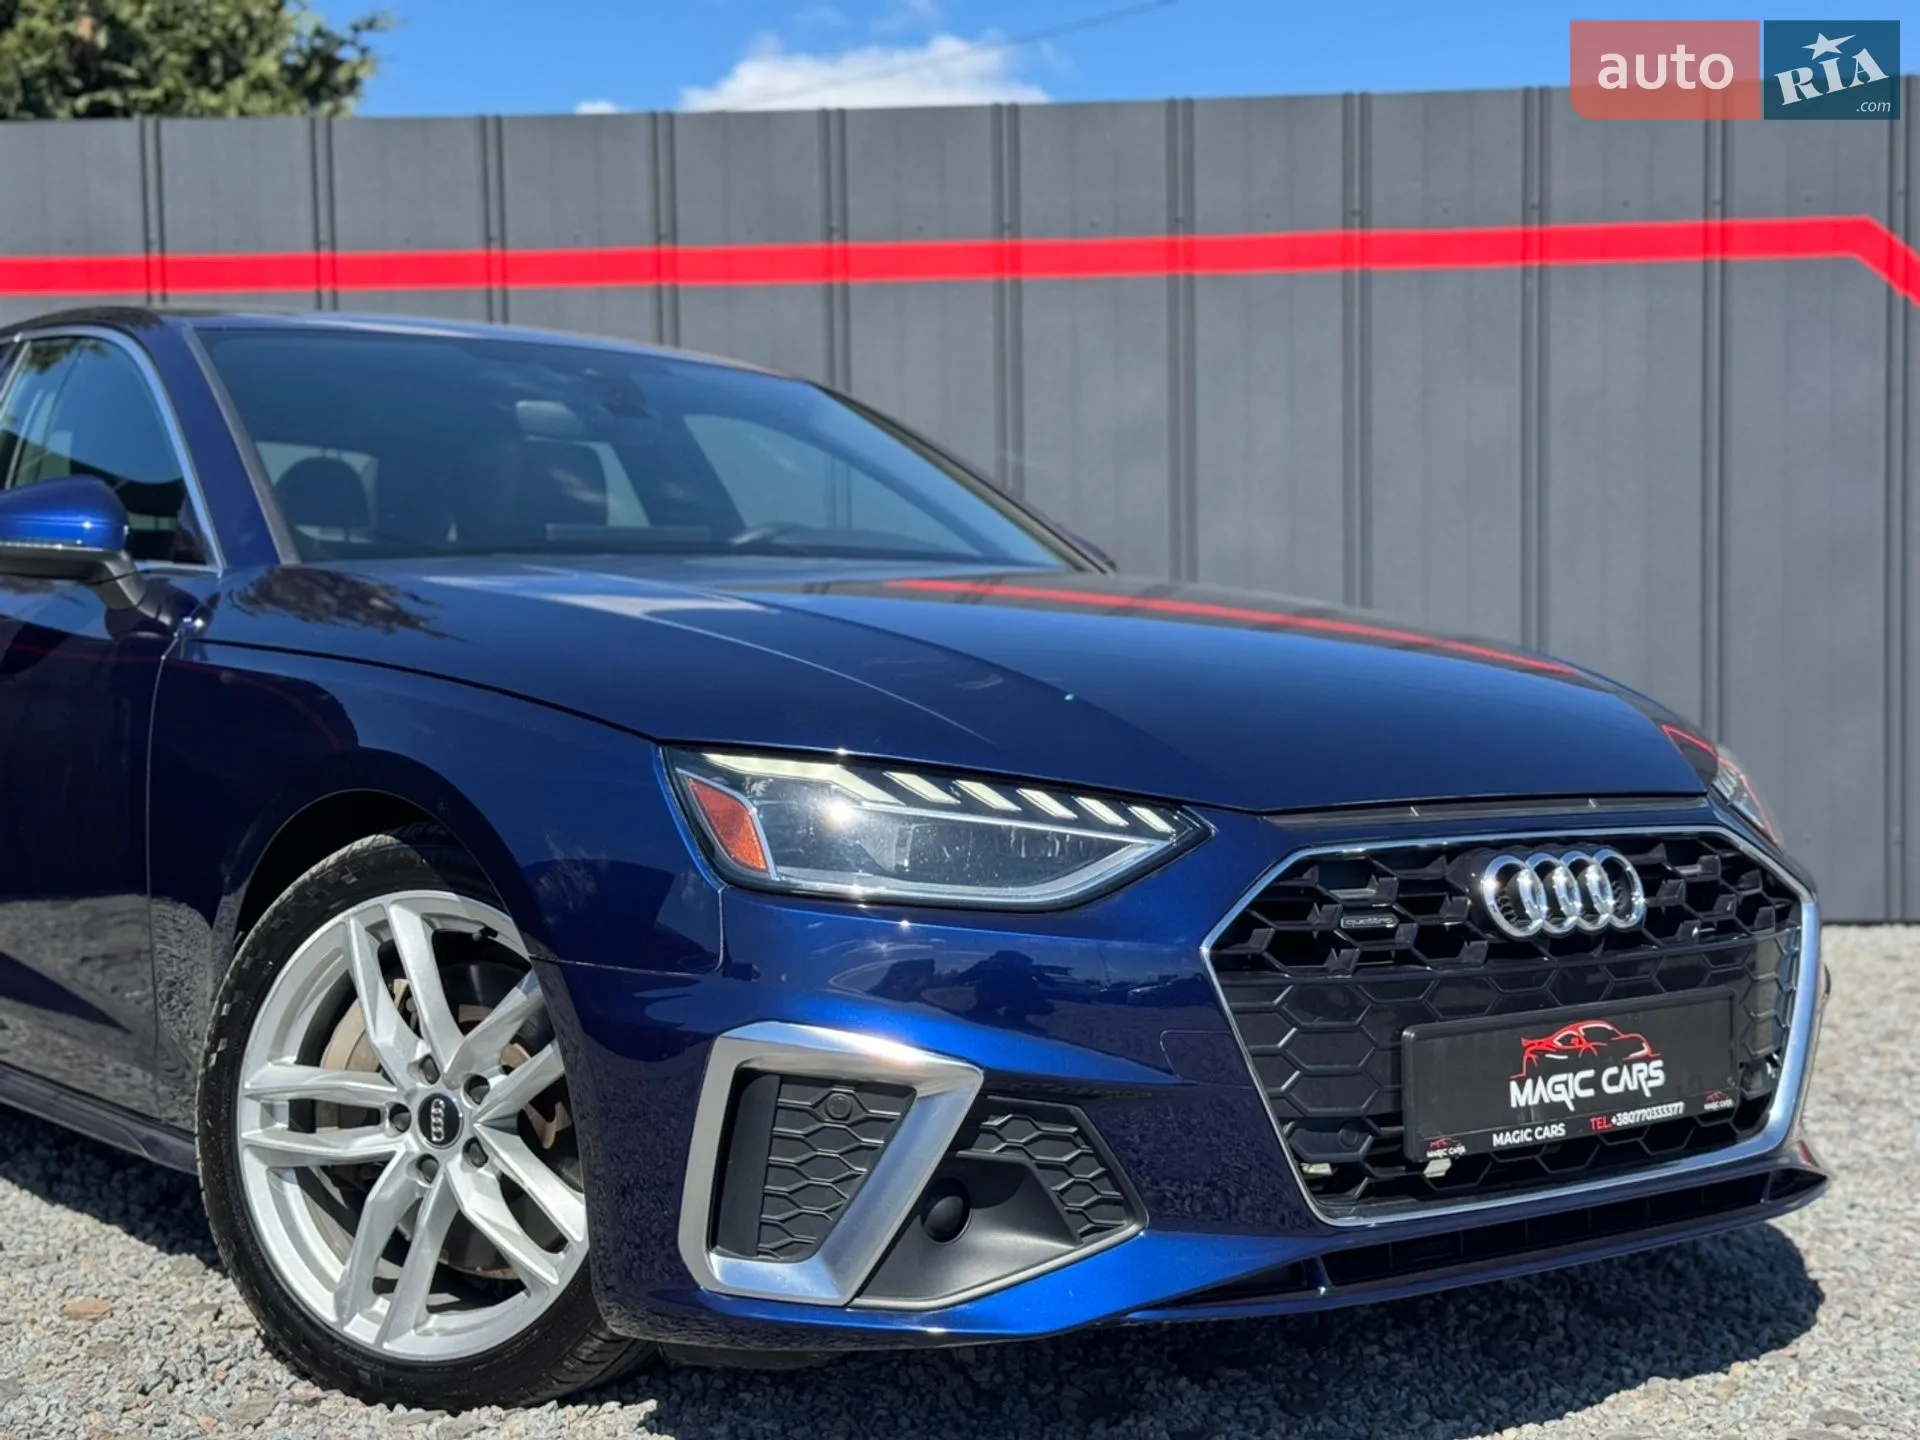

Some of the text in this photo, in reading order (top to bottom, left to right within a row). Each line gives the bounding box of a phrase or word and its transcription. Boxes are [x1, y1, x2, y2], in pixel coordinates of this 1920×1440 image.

[1510, 1059, 1666, 1111] MAGIC CARS
[1492, 1122, 1566, 1147] MAGIC CARS
